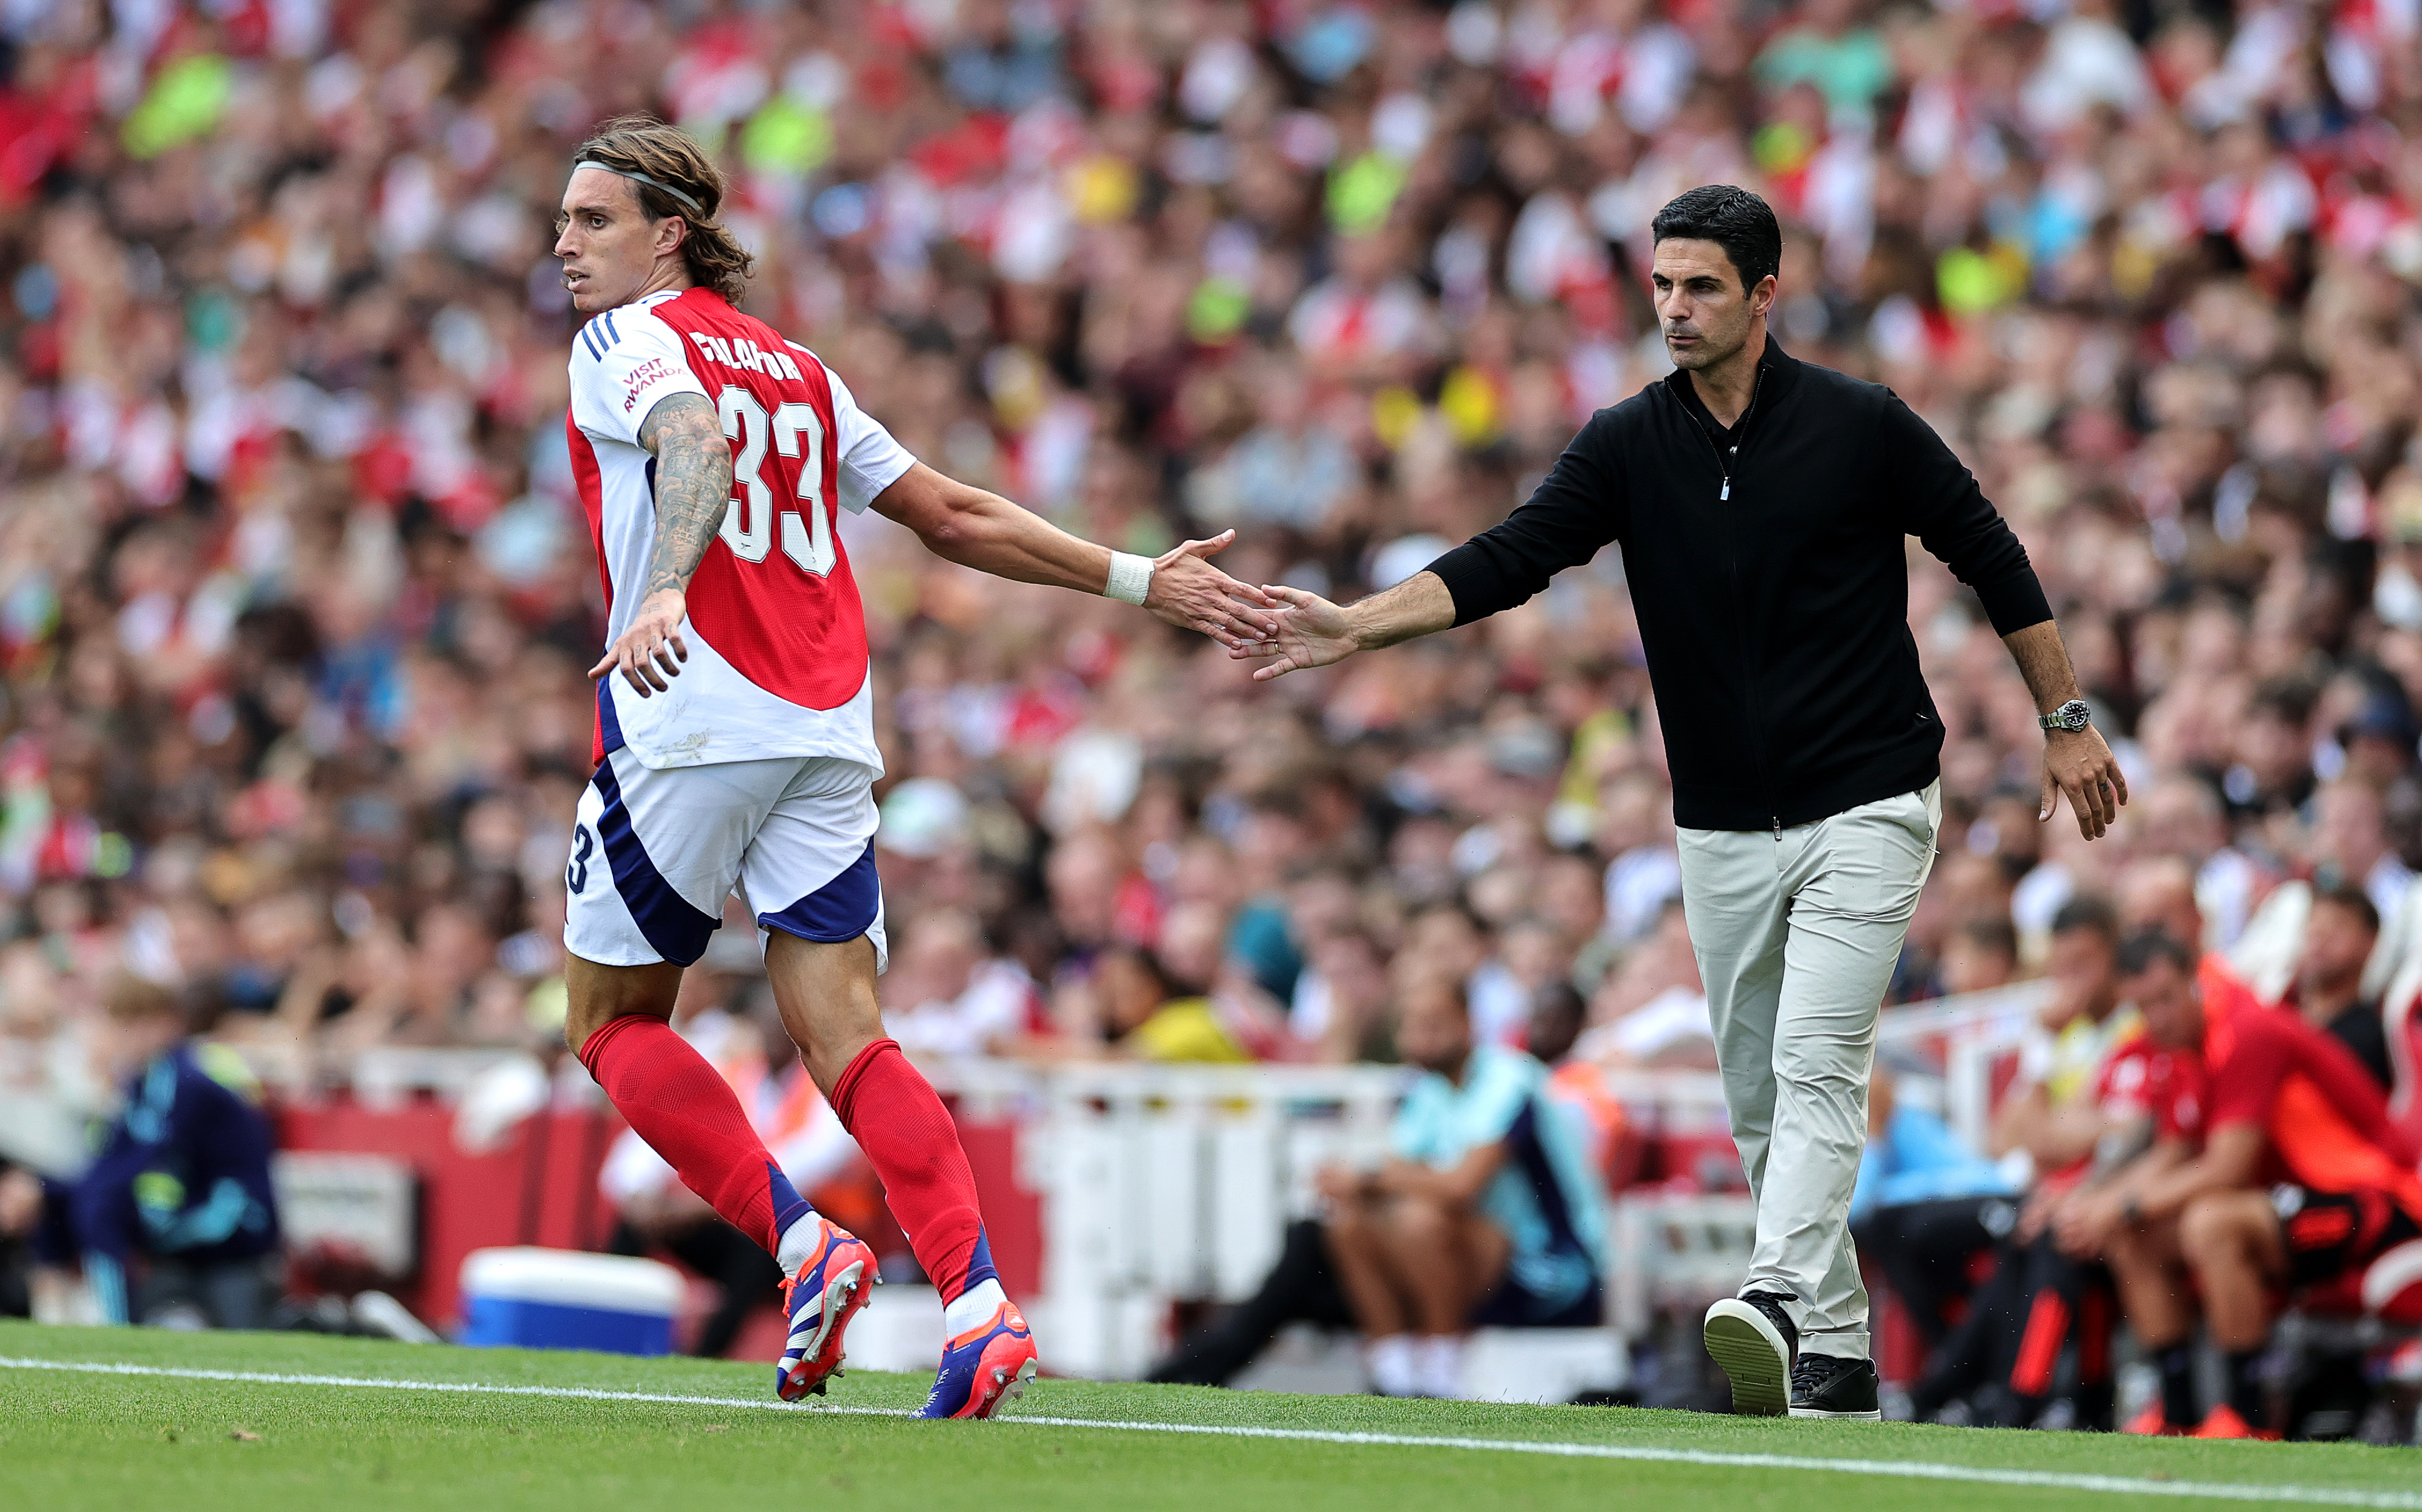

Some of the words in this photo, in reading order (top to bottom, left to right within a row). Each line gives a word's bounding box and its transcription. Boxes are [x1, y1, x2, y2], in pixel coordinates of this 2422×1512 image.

[622, 358, 662, 385] VISIT
[624, 368, 689, 414] RWANDA
[716, 384, 837, 578] 33
[568, 821, 593, 897] 3
